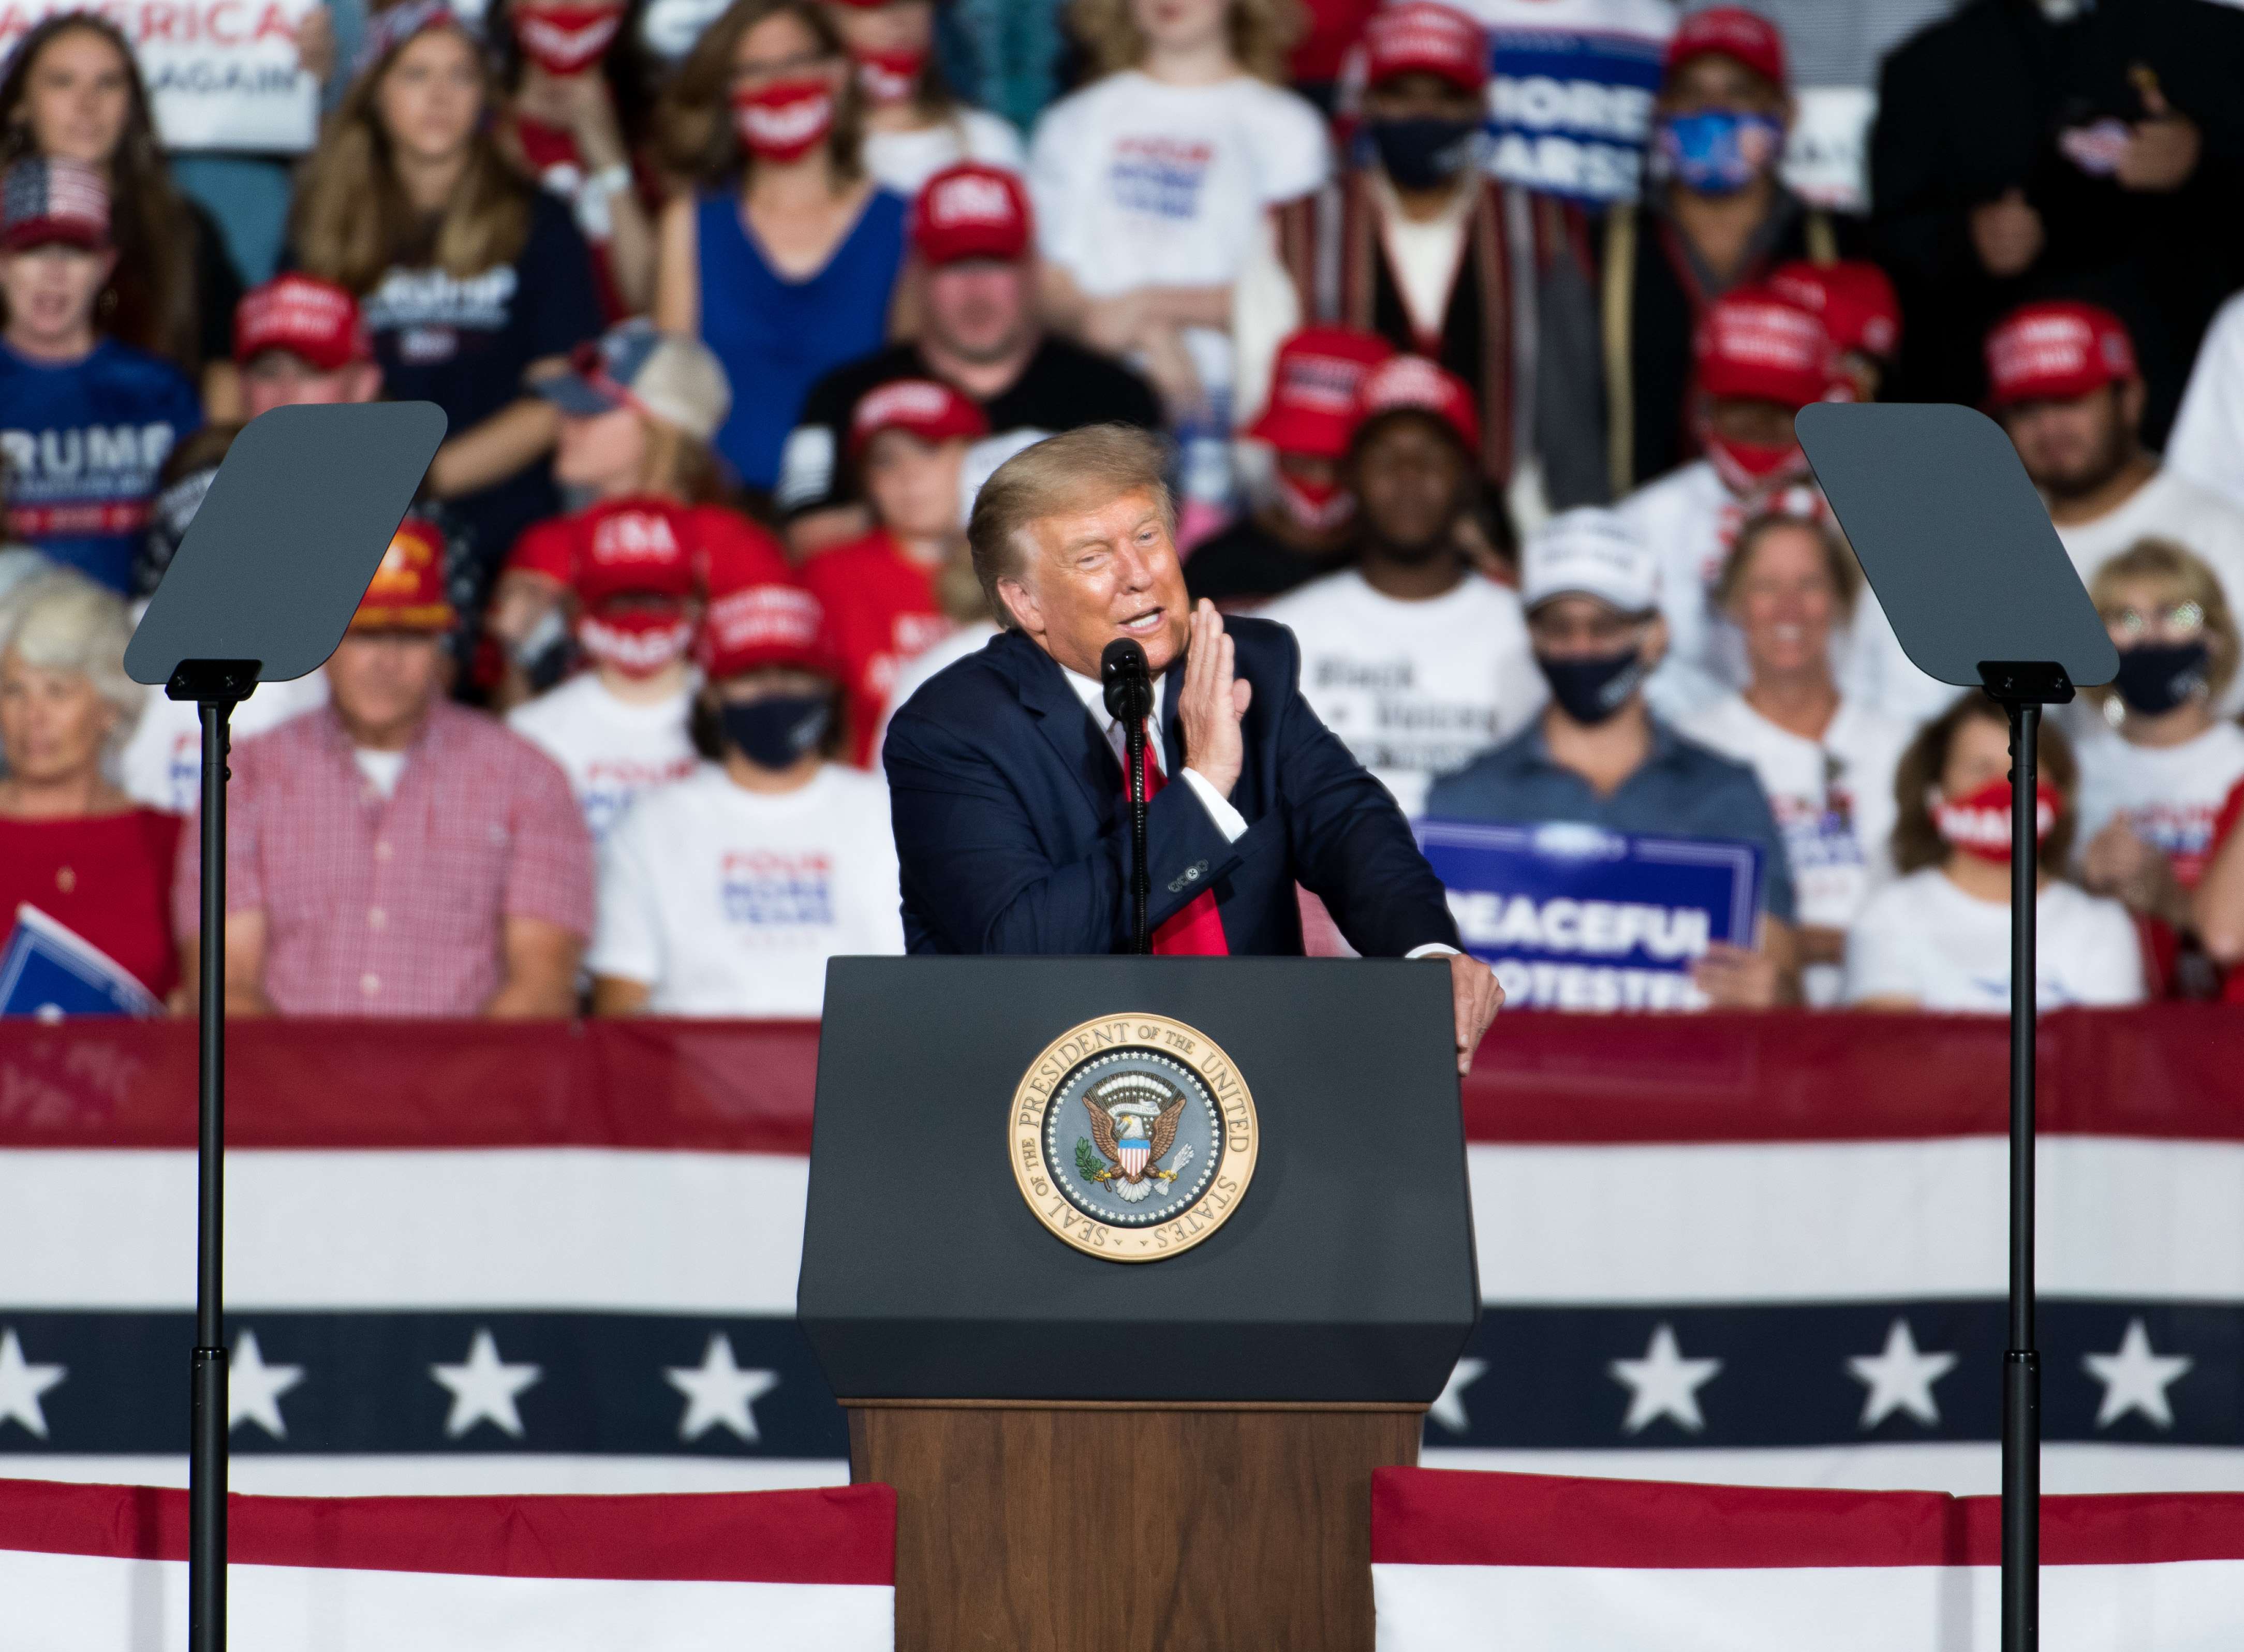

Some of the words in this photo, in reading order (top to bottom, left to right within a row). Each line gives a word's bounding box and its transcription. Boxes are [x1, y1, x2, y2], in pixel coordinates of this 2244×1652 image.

[0, 2, 298, 45] ARICA
[1138, 1024, 1161, 1040] OF
[1165, 1029, 1196, 1055] THE
[1018, 1022, 1130, 1128] PRESIDENT
[1201, 1052, 1250, 1153] UNITED
[1021, 1137, 1039, 1172] THE
[1029, 1175, 1049, 1197] OF
[1048, 1196, 1109, 1247] SEAL
[1154, 1175, 1238, 1248] STATES
